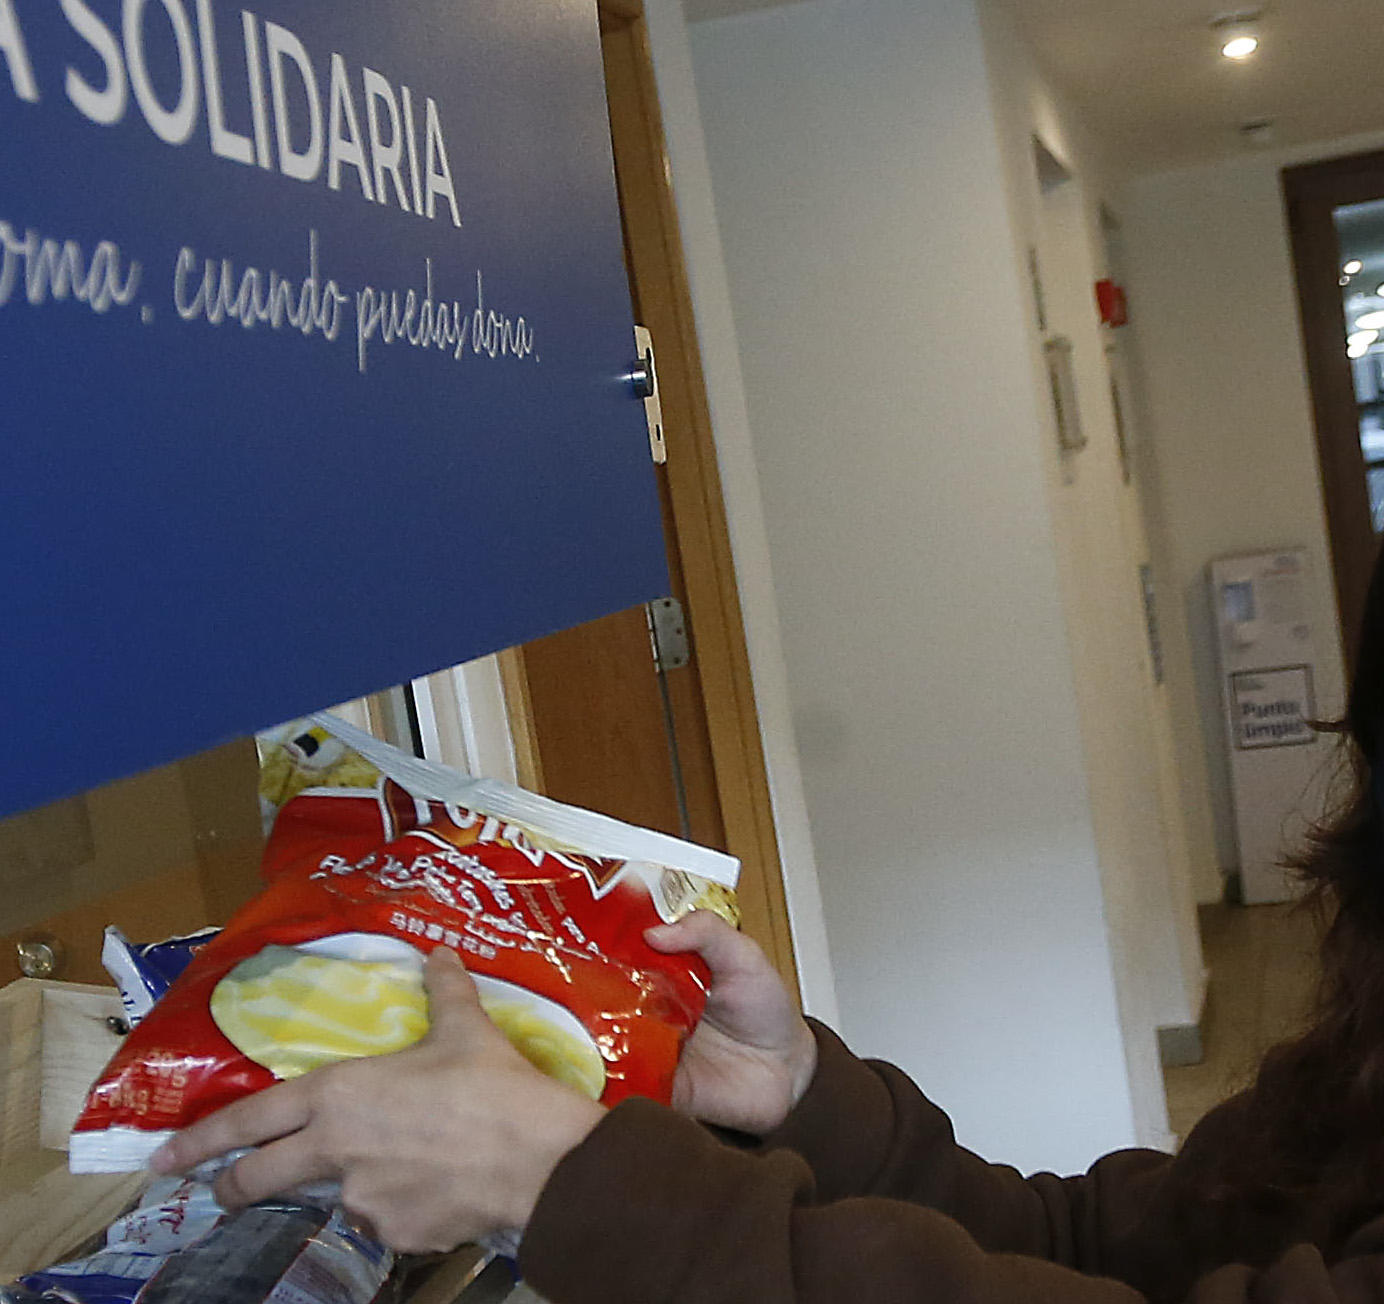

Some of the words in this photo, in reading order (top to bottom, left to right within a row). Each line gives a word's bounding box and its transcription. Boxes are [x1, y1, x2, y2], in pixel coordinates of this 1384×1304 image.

[64, 0, 463, 229] SOLIDARIA
[173, 227, 349, 342] cuando
[355, 257, 468, 374] puedas
